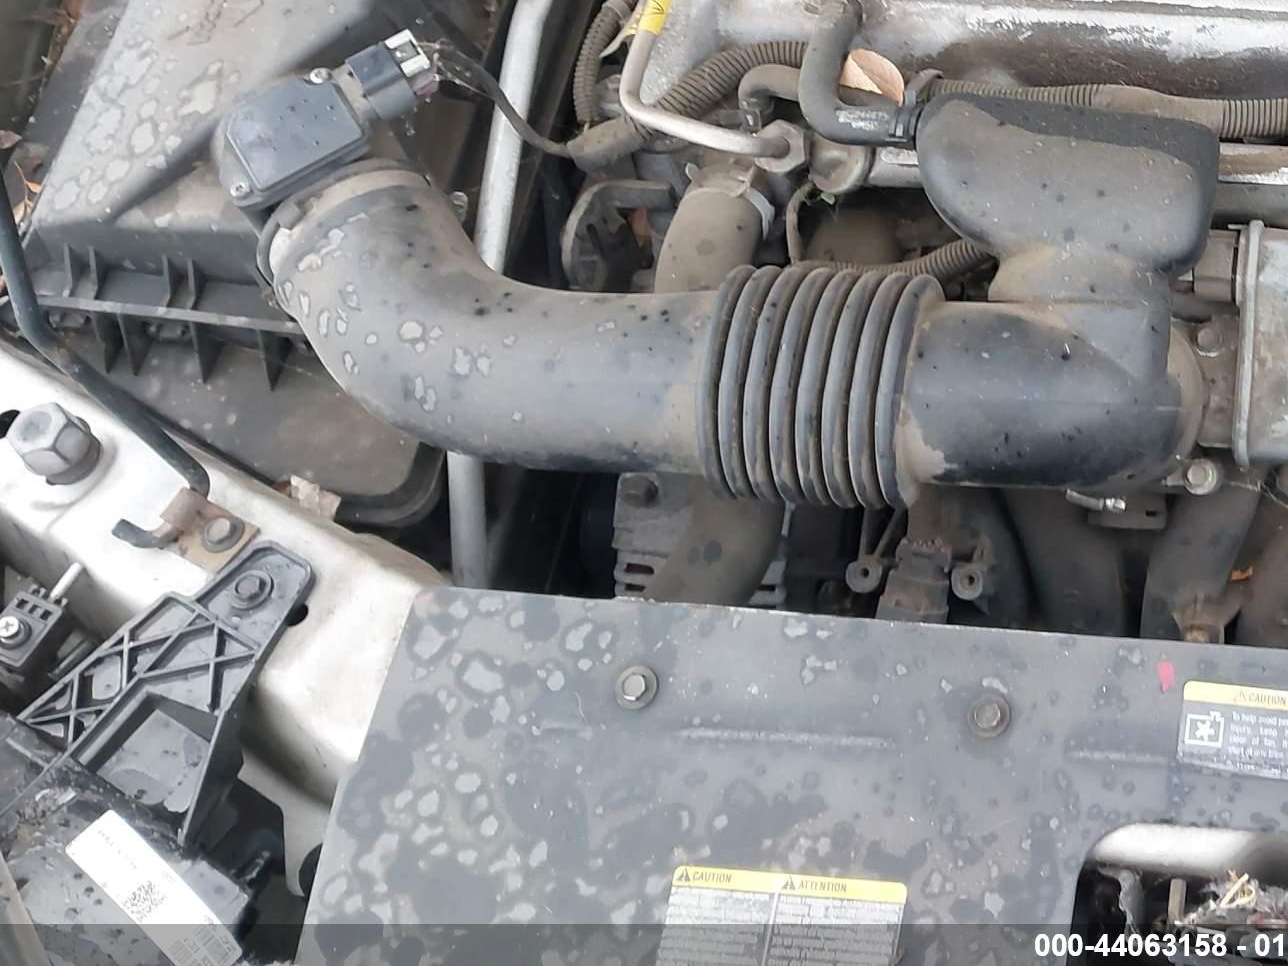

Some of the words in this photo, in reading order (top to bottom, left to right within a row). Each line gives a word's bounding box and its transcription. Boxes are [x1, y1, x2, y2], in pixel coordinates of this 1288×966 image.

[1248, 693, 1287, 707] CAUTION
[692, 871, 733, 883] CAUTION
[798, 881, 847, 893] ATTENTION
